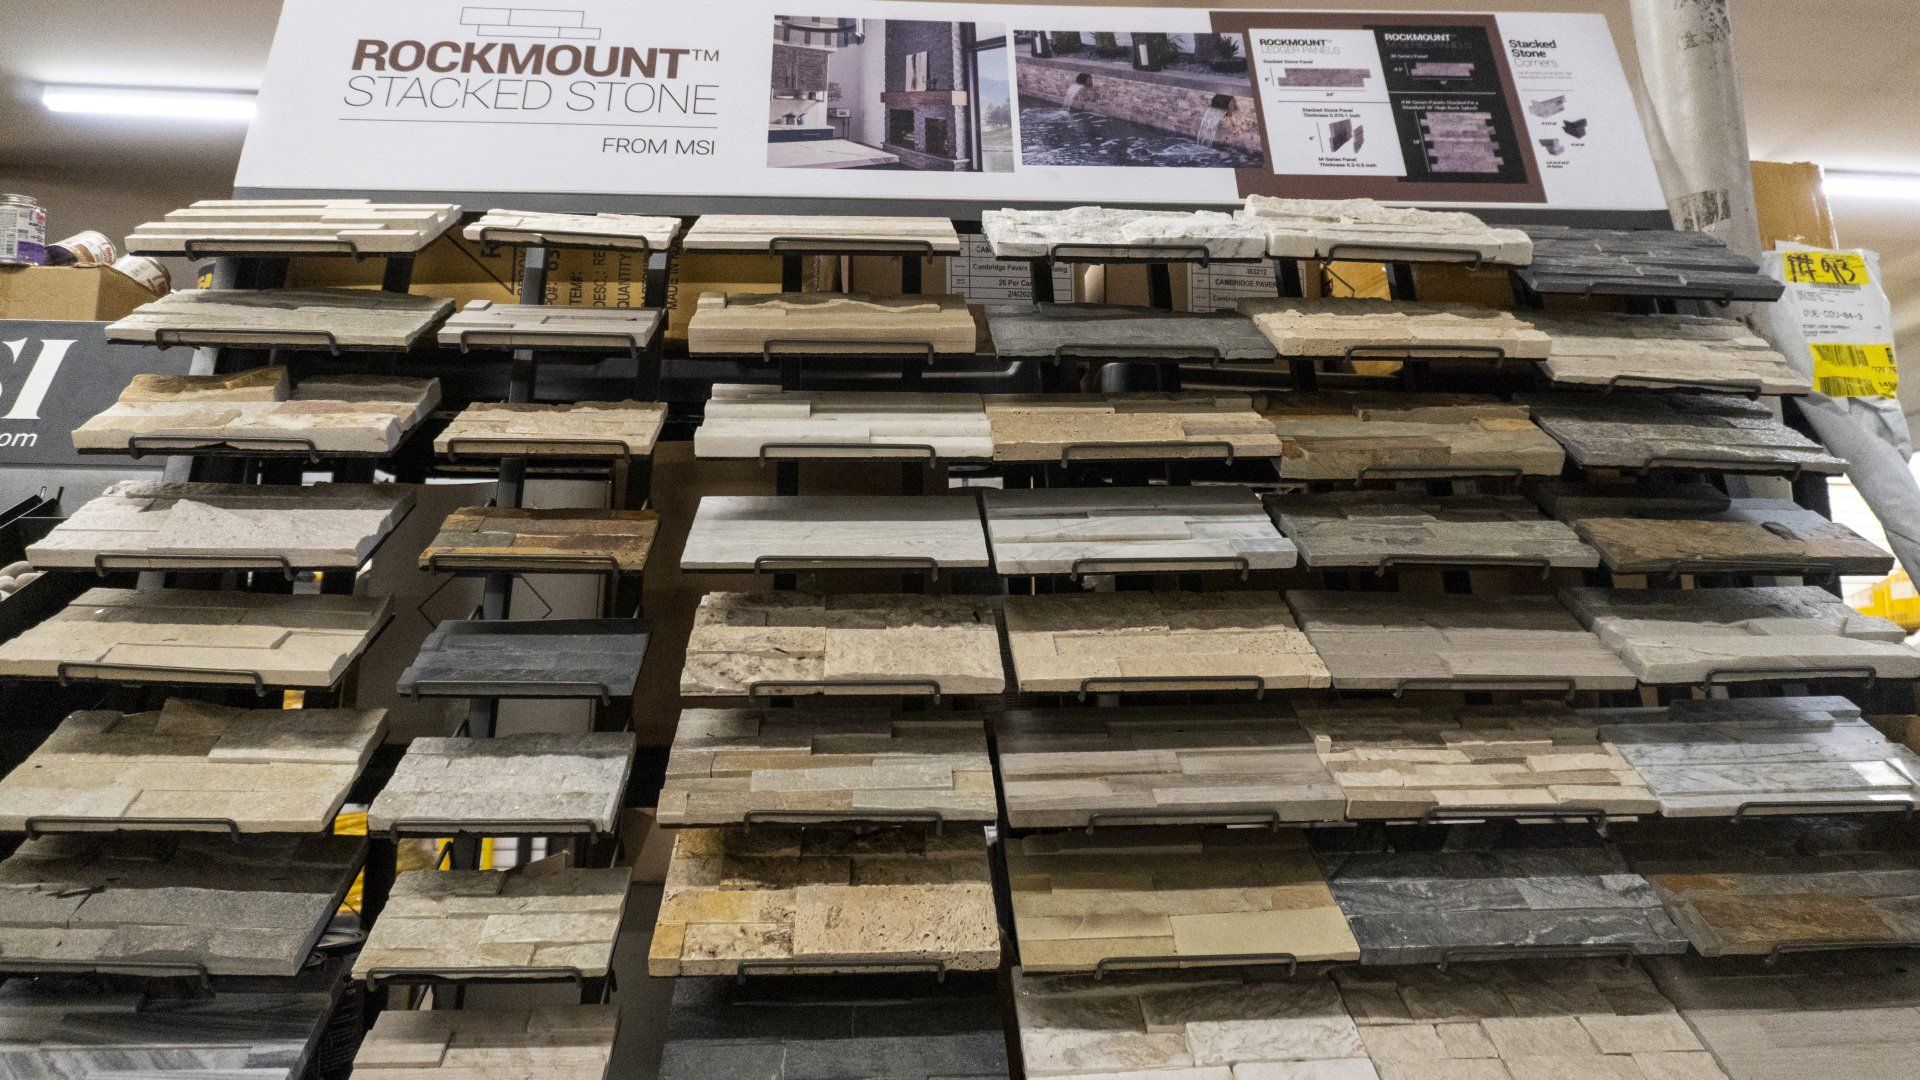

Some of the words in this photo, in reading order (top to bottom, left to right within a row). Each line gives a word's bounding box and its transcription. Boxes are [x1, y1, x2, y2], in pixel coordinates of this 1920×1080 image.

[1508, 39, 1558, 49] Stacked
[1261, 46, 1301, 54] LEDGER
[1511, 49, 1547, 58] Stone
[343, 75, 552, 110] STACKED
[566, 80, 720, 114] STONE
[602, 137, 668, 154] FROM
[675, 138, 716, 155] MSI
[972, 263, 1006, 272] Cambridge
[1007, 264, 1028, 272] Pavers
[1008, 280, 1019, 288] Per
